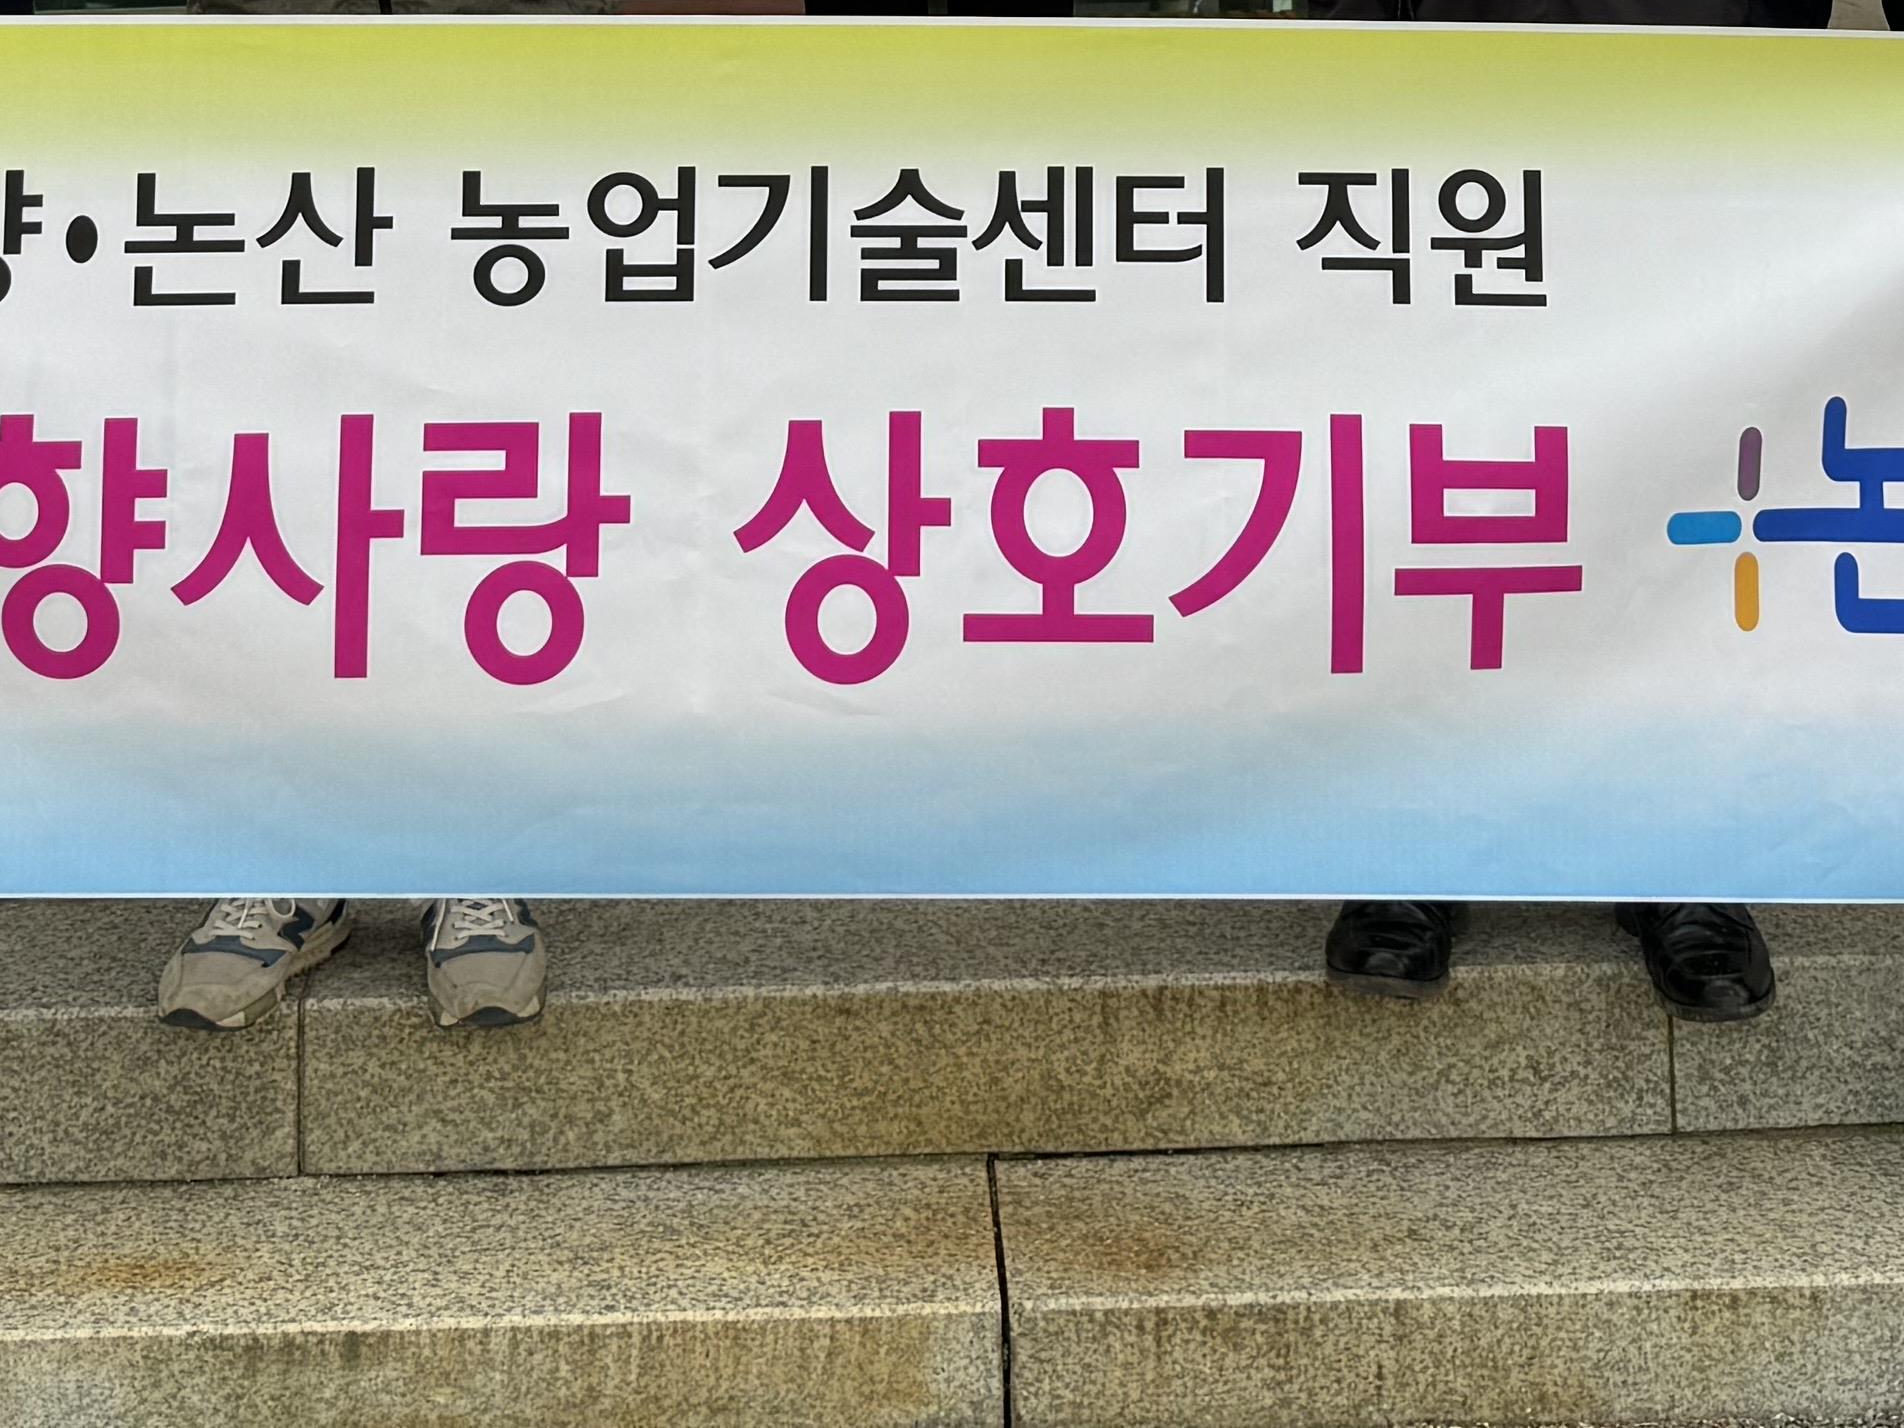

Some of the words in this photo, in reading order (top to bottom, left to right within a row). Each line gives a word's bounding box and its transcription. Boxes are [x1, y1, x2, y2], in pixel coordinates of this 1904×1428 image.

[451, 166, 1224, 306] 농업기술센터
[1297, 169, 1546, 306] 직원
[735, 408, 1582, 684] 상호기부
